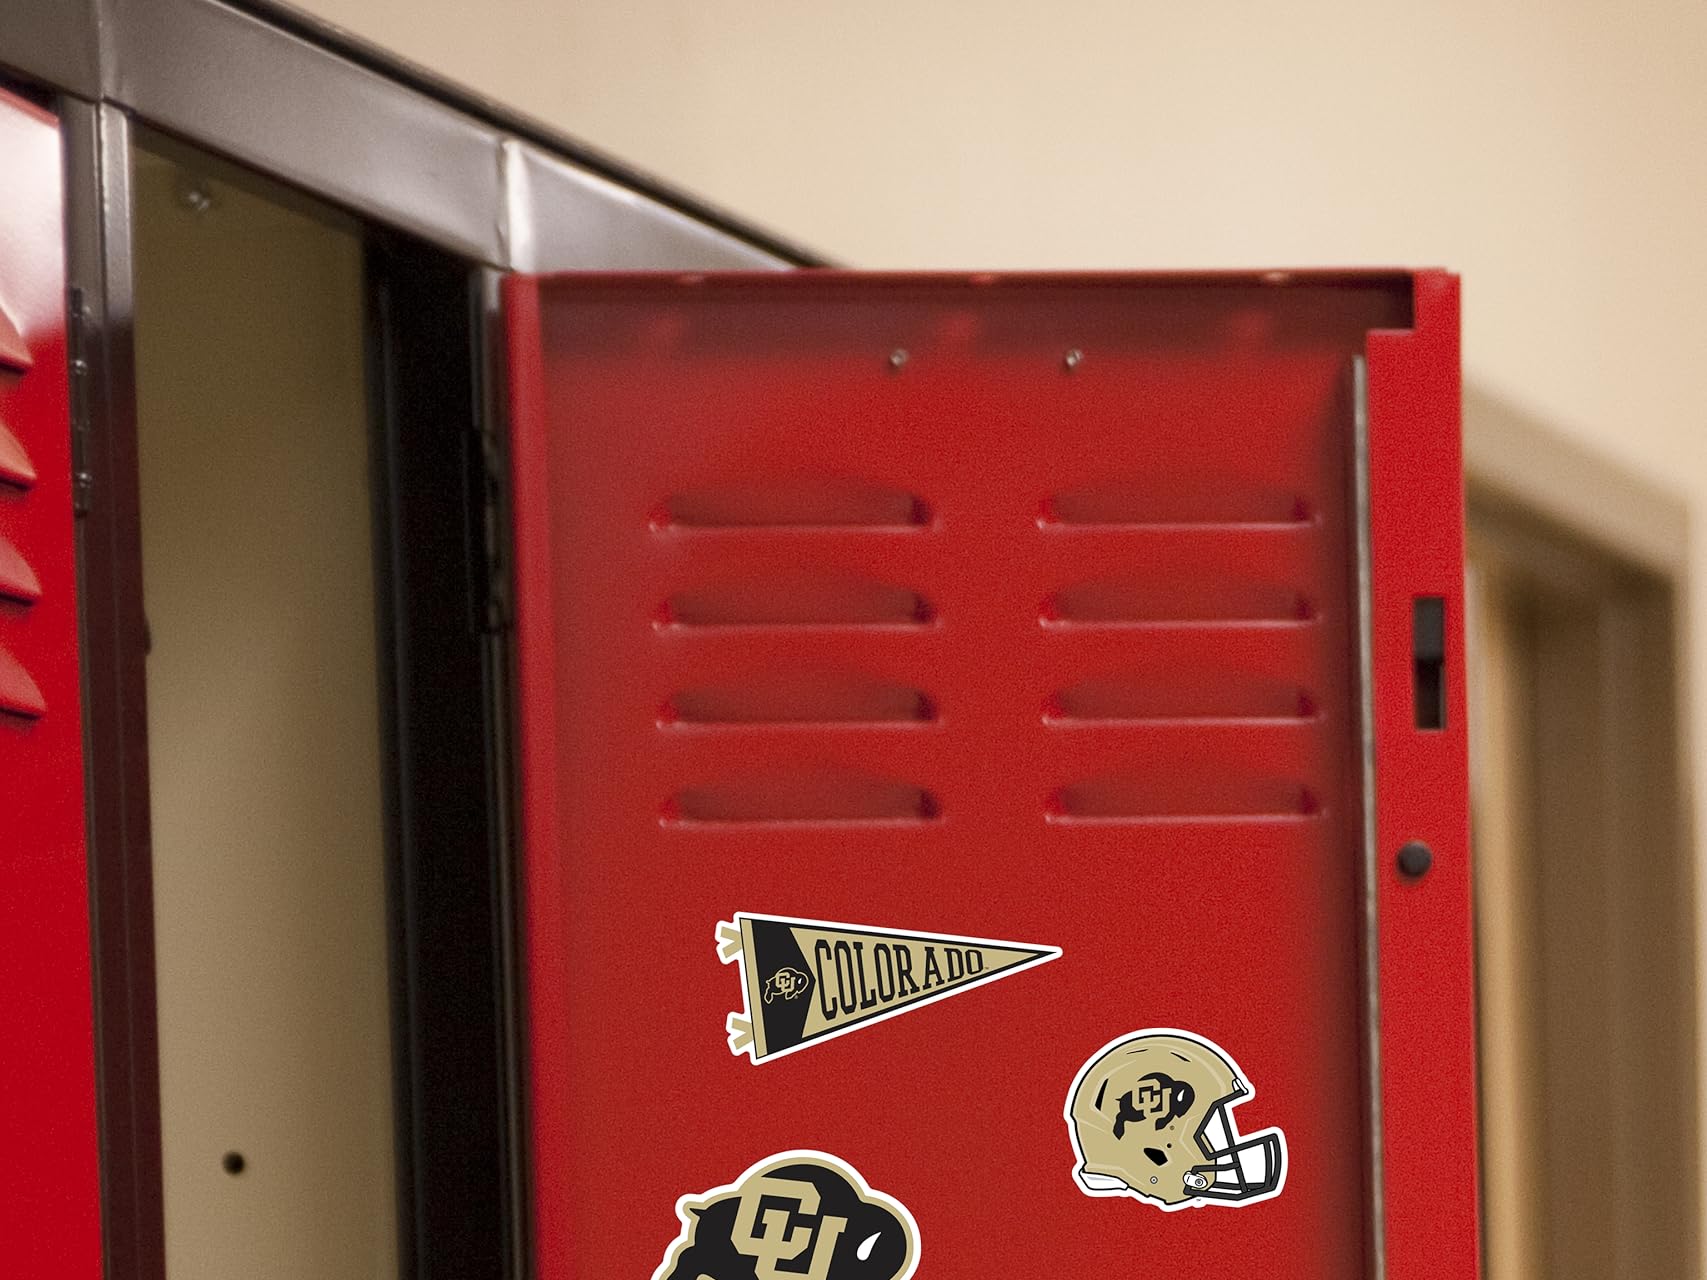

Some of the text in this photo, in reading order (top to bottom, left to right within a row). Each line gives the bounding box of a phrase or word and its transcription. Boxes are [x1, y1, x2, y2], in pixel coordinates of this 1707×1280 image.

[776, 972, 795, 992] CU
[814, 939, 983, 1020] COLORADO
[1131, 1079, 1172, 1120] CU
